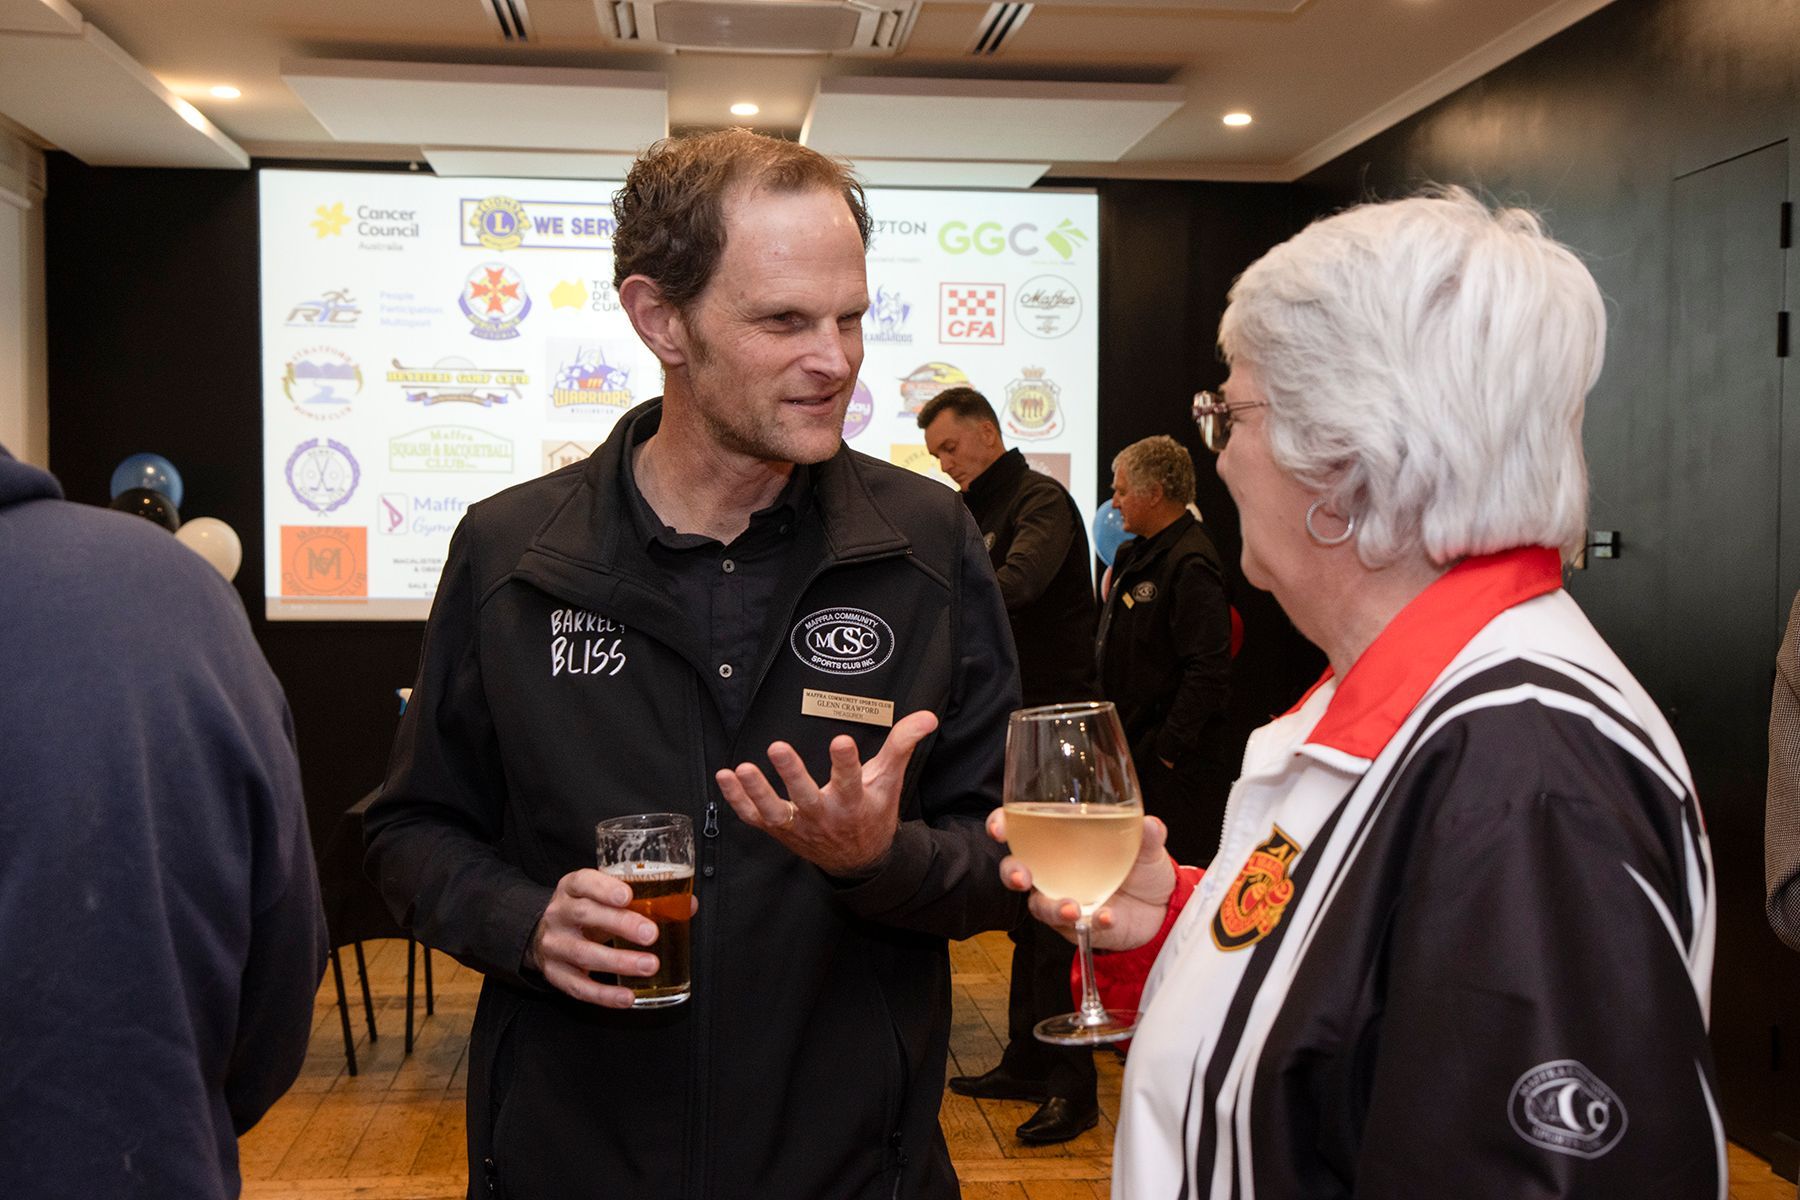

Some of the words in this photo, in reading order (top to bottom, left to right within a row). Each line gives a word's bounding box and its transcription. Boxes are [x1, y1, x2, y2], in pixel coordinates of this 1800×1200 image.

[357, 204, 417, 221] Cancer
[357, 221, 420, 237] Council
[533, 216, 564, 235] WE
[937, 220, 1040, 257] GGC
[947, 320, 996, 339] CFA
[554, 386, 631, 408] WARRIORS
[804, 613, 835, 630] MAFFRA
[834, 612, 879, 629] COMMUNITY
[550, 635, 627, 677] BLISS
[811, 655, 842, 669] SPORTS
[842, 661, 862, 669] CLUB
[806, 691, 827, 700] MAFFRA
[827, 694, 859, 705] COMMUNITY
[859, 699, 878, 707] SPORTS
[816, 699, 841, 710] GLENN
[841, 702, 880, 715] CRAWFORD
